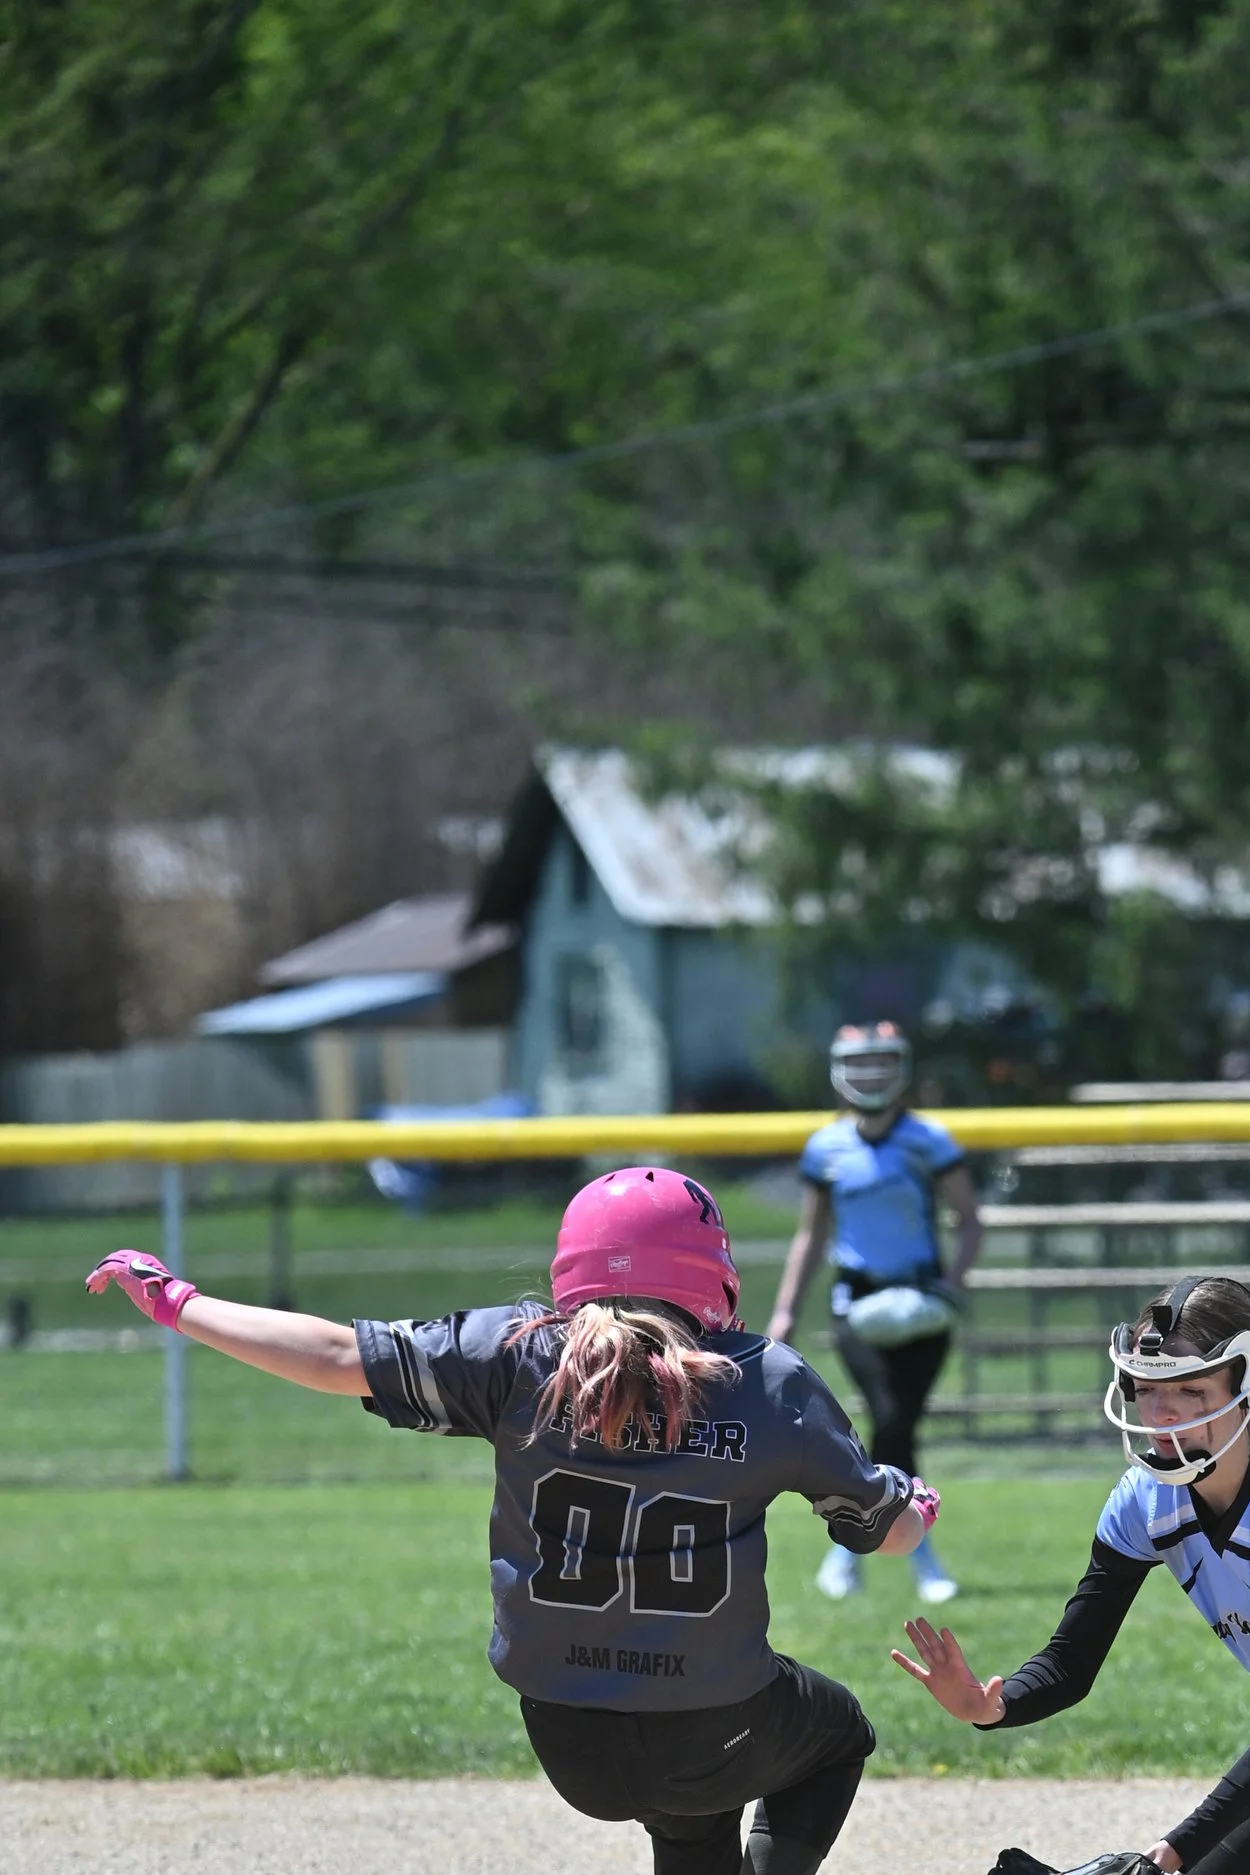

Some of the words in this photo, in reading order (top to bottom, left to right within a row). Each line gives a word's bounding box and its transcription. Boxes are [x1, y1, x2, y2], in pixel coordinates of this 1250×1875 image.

[530, 1468, 732, 1618] 00
[565, 1644, 611, 1670] J&M
[616, 1650, 686, 1677] GRAFIX
